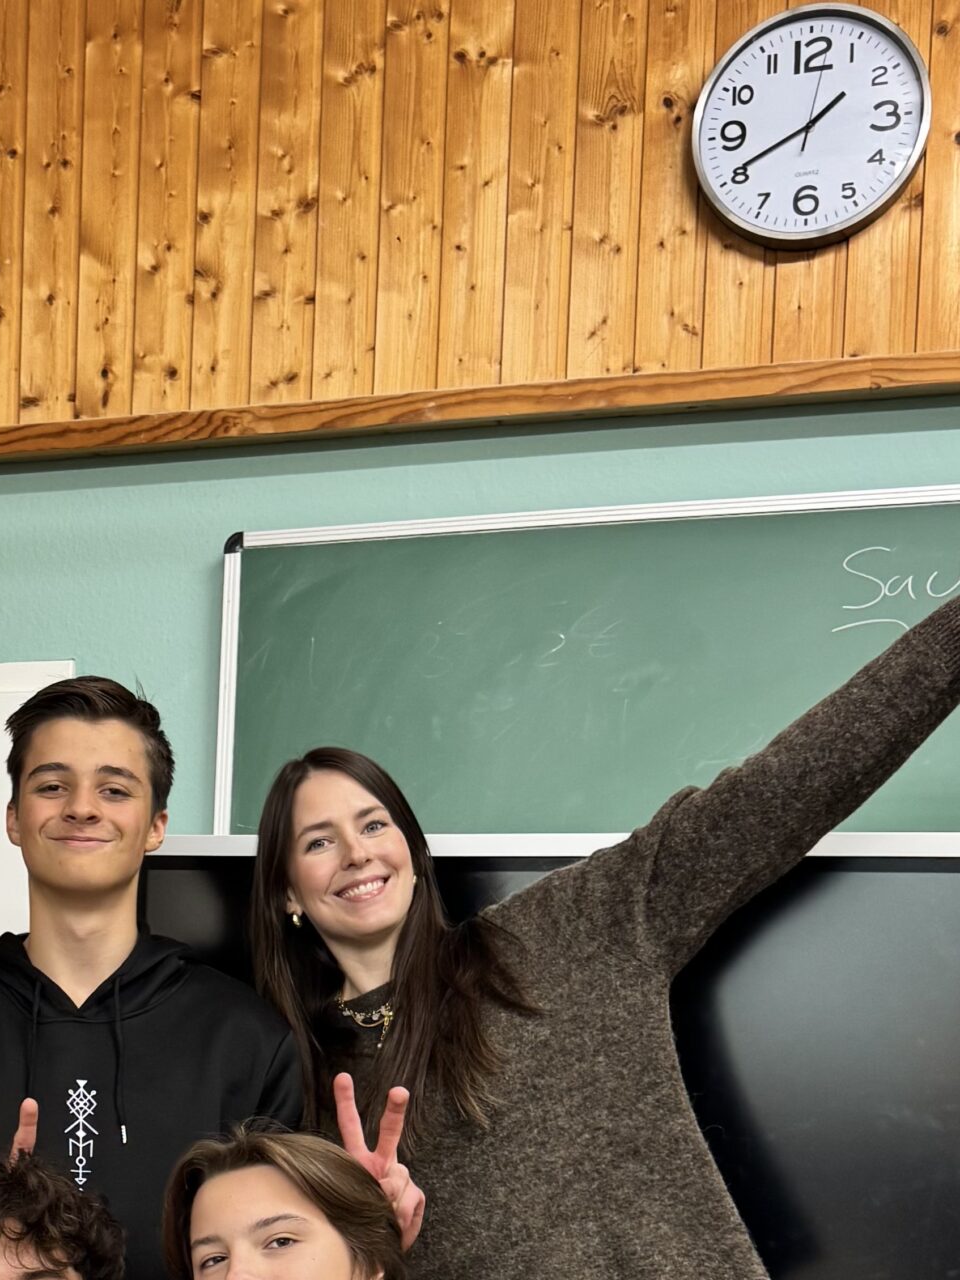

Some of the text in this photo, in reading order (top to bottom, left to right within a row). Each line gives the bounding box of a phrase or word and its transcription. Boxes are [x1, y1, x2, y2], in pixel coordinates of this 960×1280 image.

[794, 36, 833, 75] 12
[850, 42, 855, 63] 1
[767, 53, 778, 75] 11
[871, 66, 888, 86] 2
[731, 84, 754, 106] 10
[869, 100, 901, 131] 3
[720, 120, 747, 151] 9
[867, 149, 885, 165] 4
[731, 165, 749, 185] 8
[792, 185, 819, 216] 6
[841, 182, 856, 199] 5
[757, 192, 771, 211] 7
